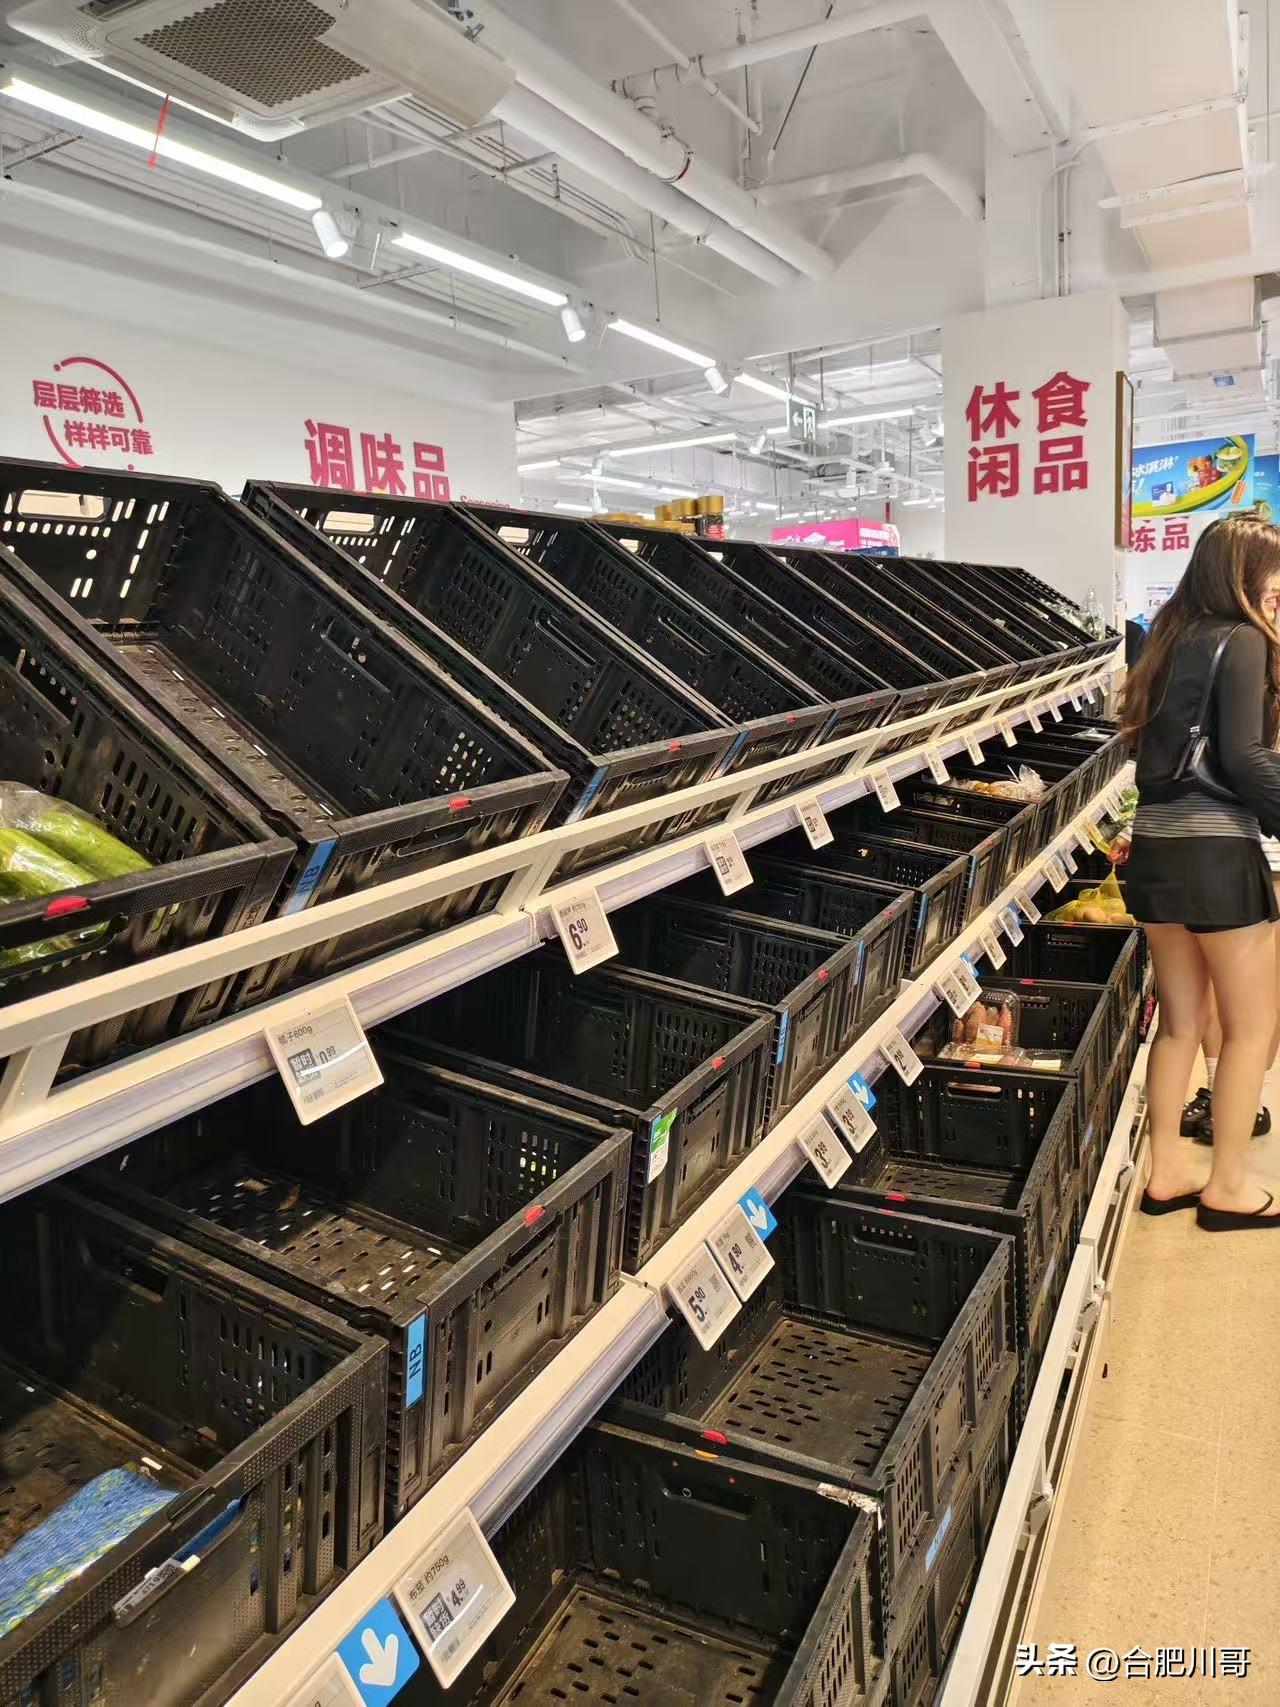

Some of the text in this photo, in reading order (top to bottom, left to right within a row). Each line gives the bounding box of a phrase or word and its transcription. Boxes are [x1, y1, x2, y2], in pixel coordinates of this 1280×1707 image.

[32, 380, 126, 418] 层层筛选
[64, 419, 154, 455] 样样可靠
[304, 419, 451, 501] 调味品
[568, 918, 588, 950] 6.90
[728, 1242, 744, 1275] 4.90
[687, 1286, 707, 1323] 5.90
[408, 1343, 422, 1380] NB
[450, 1578, 466, 1608] 4.99
